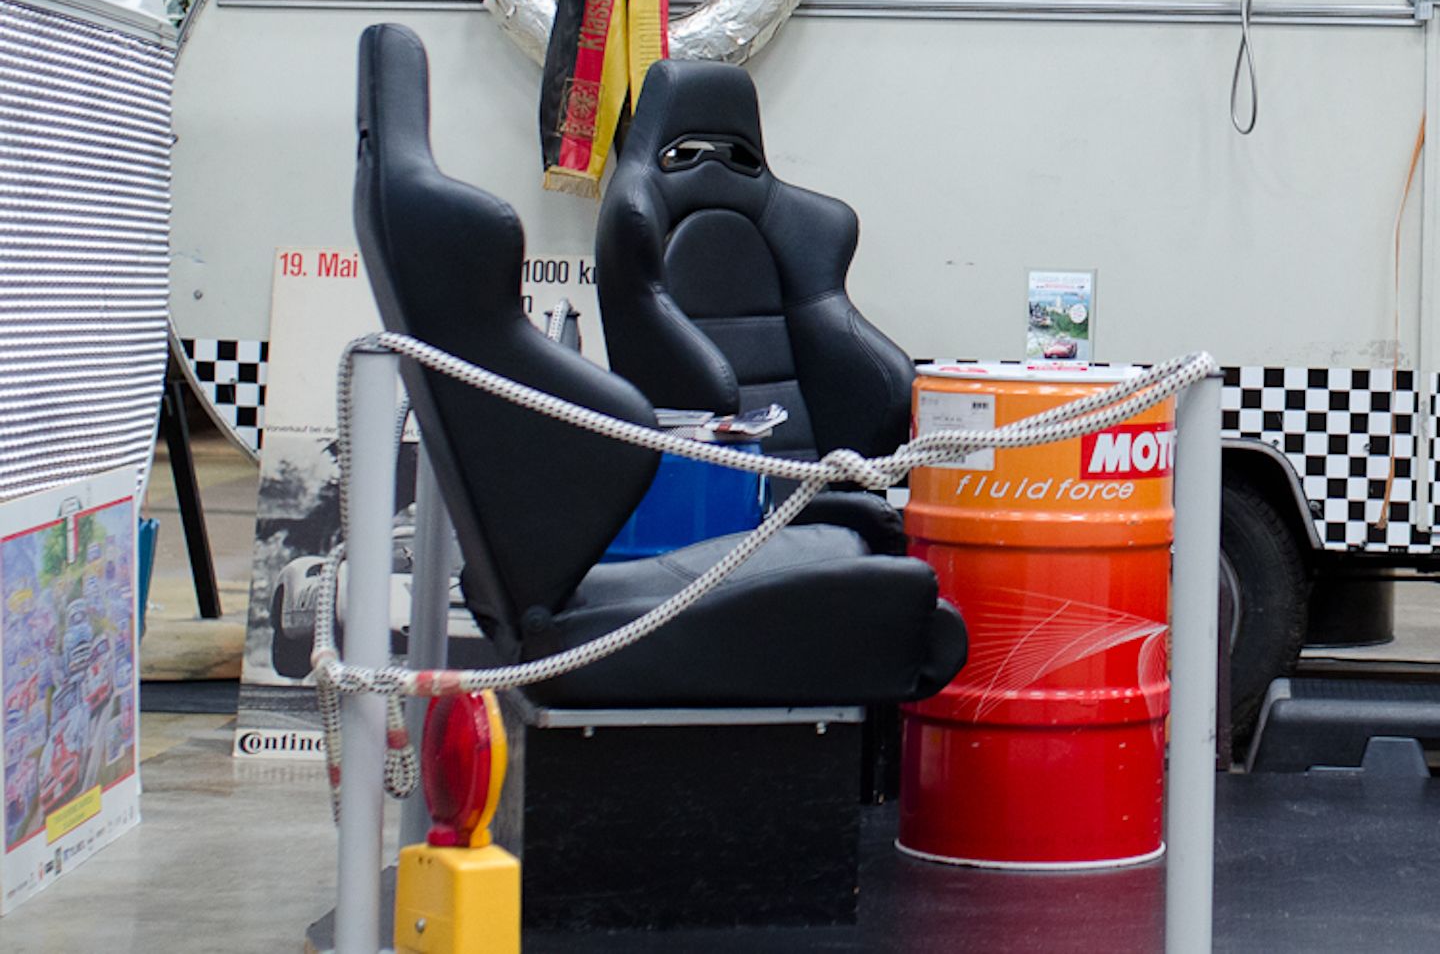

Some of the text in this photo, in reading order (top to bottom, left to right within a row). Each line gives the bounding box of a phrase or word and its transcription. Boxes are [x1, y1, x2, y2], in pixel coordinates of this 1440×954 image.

[279, 252, 359, 278] 19. Mai
[522, 258, 570, 284] 1000
[265, 424, 308, 434] Vorverkauf
[955, 475, 1136, 500] fluid force
